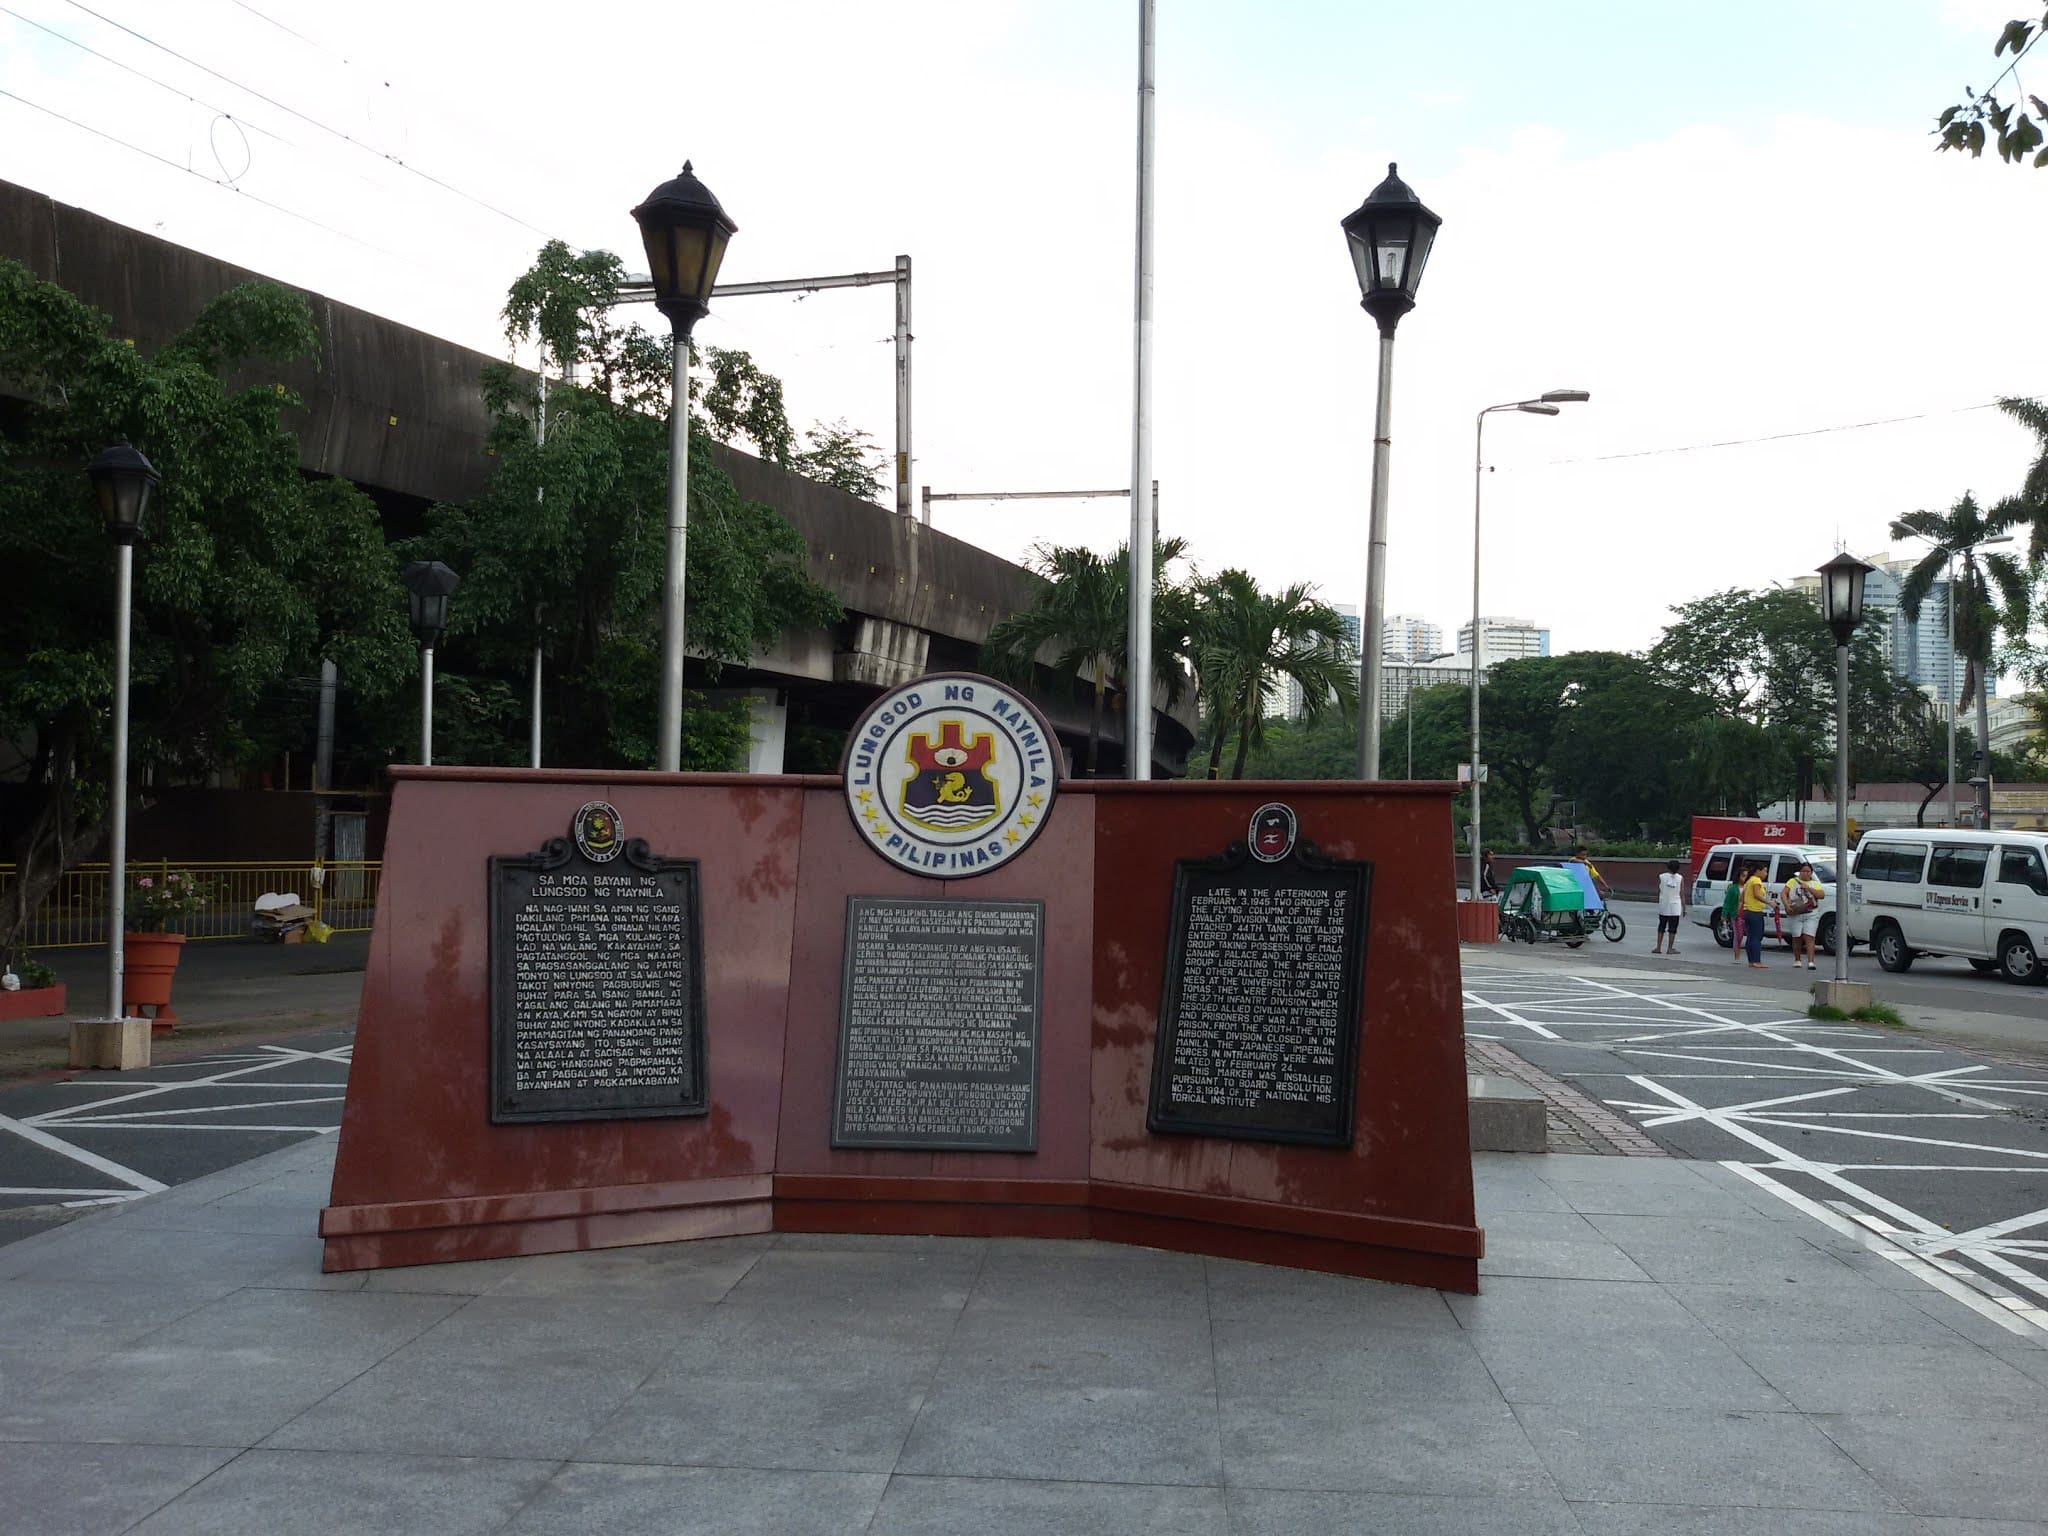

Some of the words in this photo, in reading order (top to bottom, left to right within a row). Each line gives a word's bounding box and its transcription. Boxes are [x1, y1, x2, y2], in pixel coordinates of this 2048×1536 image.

[855, 692, 922, 785] LUNGSOD
[944, 686, 974, 702] NG
[992, 699, 1046, 787] MAYNILA
[1764, 827, 1786, 836] LBC
[886, 834, 1002, 868] PILIPINAS
[1192, 897, 1236, 905] FEBRUARY
[1295, 898, 1329, 906] GROUPS
[1213, 906, 1242, 914] FLYING
[1249, 907, 1283, 915] COLUMN
[1190, 915, 1227, 923] CAVALRY
[1189, 924, 1232, 932] ATTACHED
[1188, 932, 1227, 940] ENTERED
[1232, 933, 1264, 941] MANILA
[1318, 935, 1343, 943] FIRST
[1187, 941, 1215, 949] GROUP
[1219, 942, 1247, 950] TAKING
[1319, 944, 1343, 952] MALA
[1224, 951, 1257, 959] PALACE
[1262, 952, 1280, 960] AND
[1307, 953, 1341, 961] SECOND
[1185, 959, 1213, 967] GROUP
[1296, 962, 1341, 971] AMERICAN
[1176, 1039, 1208, 1048] MANILA
[1217, 1041, 1233, 1050] THE
[1240, 1042, 1286, 1052] JAPANESE
[1293, 1046, 1334, 1055] IMPERIAL
[1175, 1048, 1207, 1057] FORCES
[1283, 1054, 1307, 1063] WERE
[1313, 1056, 1334, 1064] ANNI
[1191, 1067, 1209, 1075] THIS
[1218, 1068, 1253, 1078] MARKER
[1259, 1071, 1277, 1080] WAS
[1173, 1075, 1218, 1086] PURSUANT
[1224, 1079, 1234, 1087] TO
[1239, 1080, 1268, 1089] BOARD
